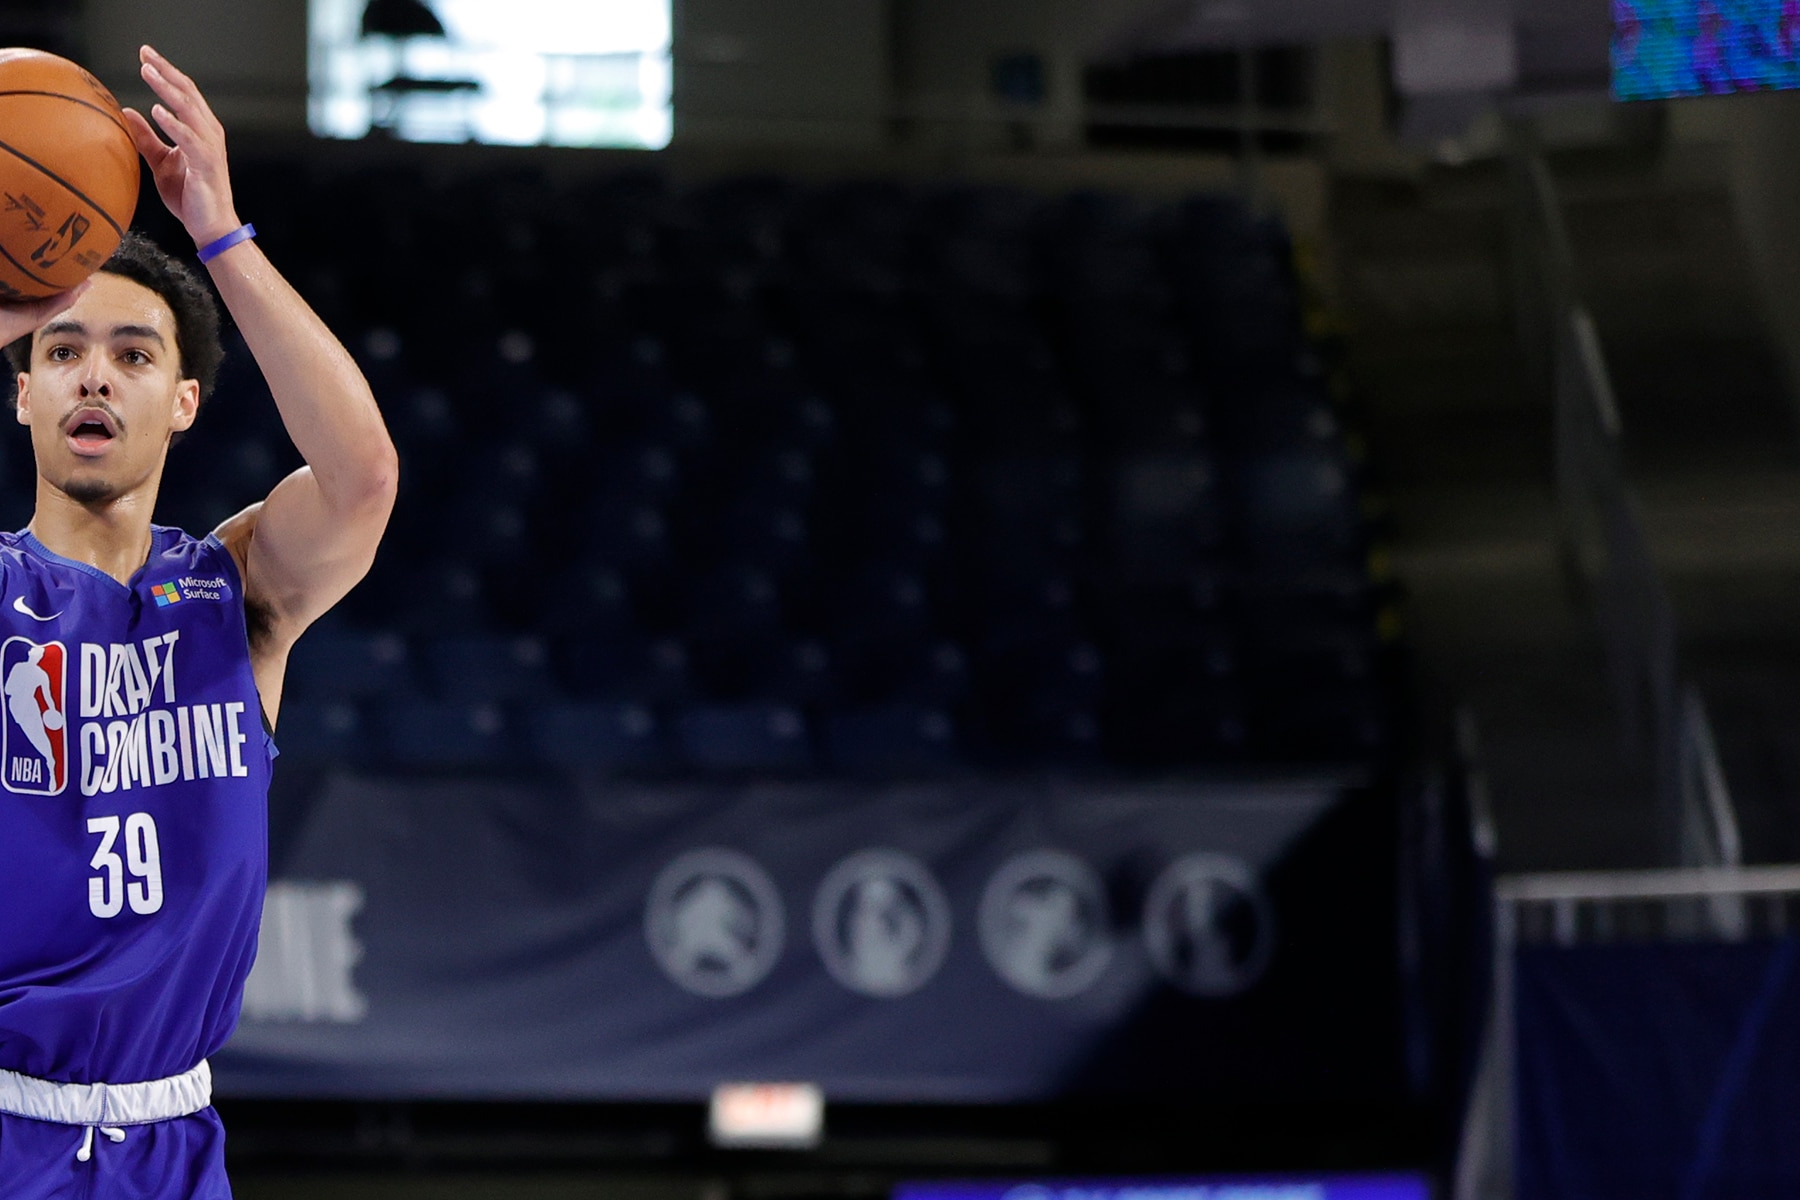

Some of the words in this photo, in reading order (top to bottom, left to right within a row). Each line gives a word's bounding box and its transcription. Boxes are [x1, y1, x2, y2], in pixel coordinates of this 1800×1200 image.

[178, 577, 227, 588] Microsoft
[183, 589, 220, 600] Surface
[80, 630, 180, 718] DRAFT
[11, 756, 43, 784] NBA
[80, 702, 248, 797] COMBINE
[87, 812, 164, 919] 39
